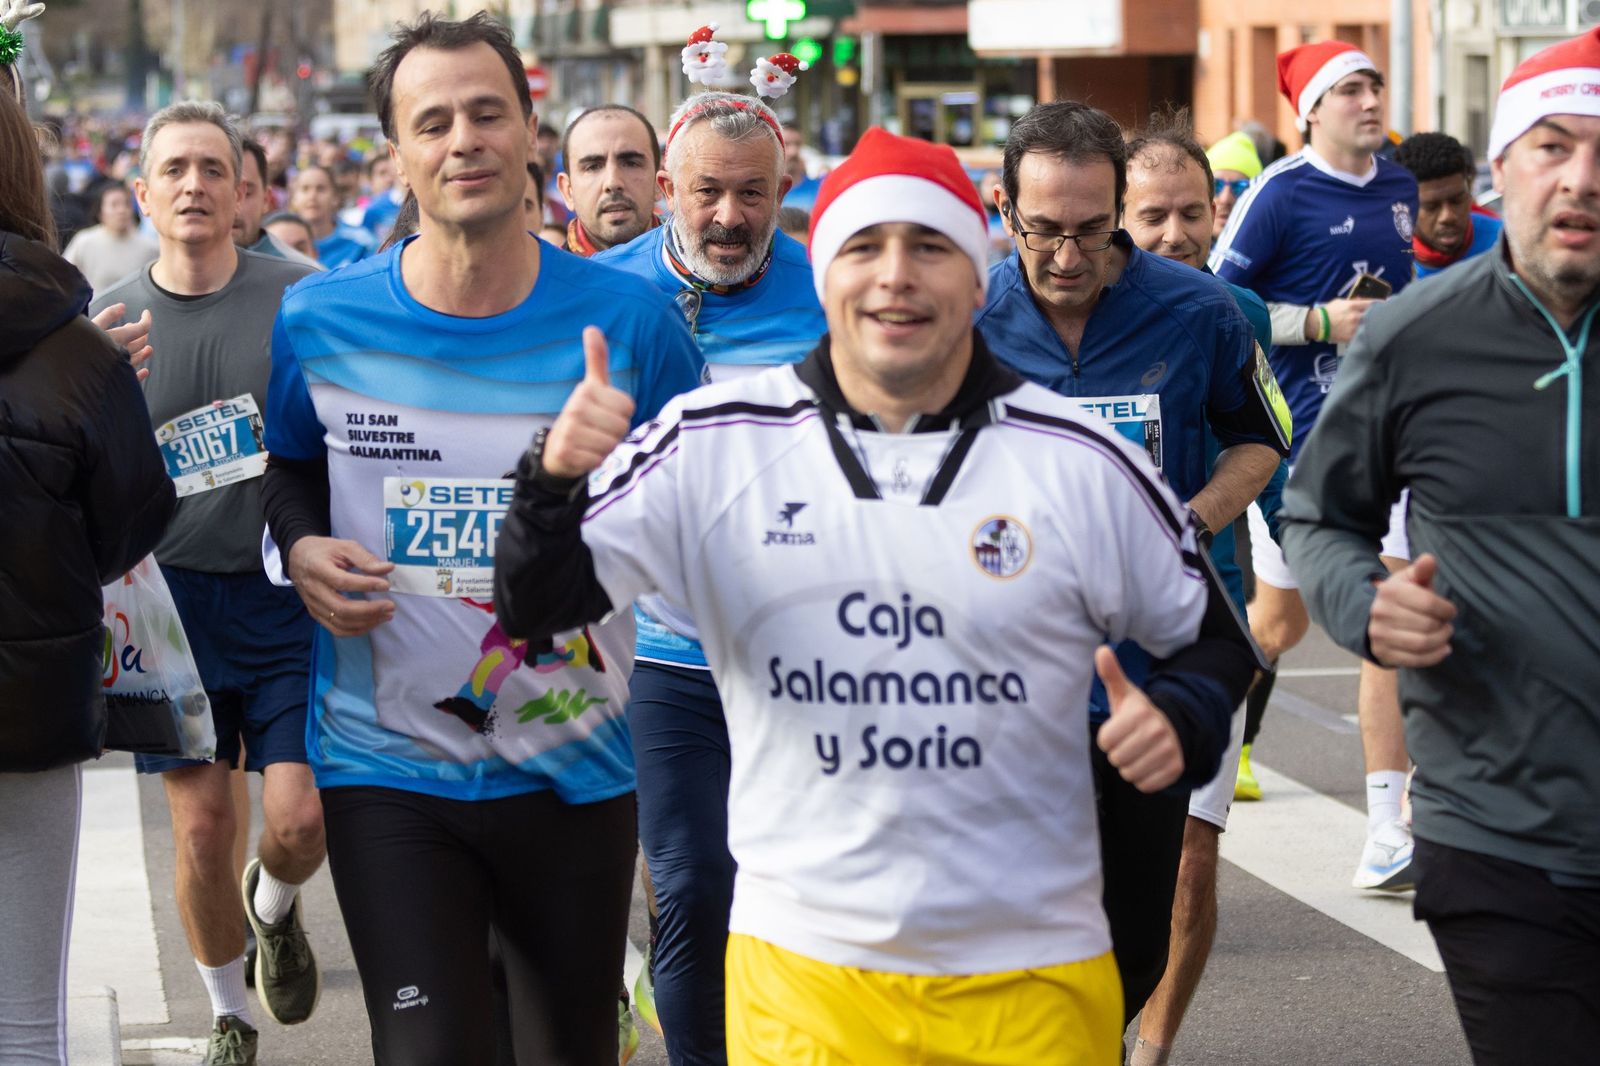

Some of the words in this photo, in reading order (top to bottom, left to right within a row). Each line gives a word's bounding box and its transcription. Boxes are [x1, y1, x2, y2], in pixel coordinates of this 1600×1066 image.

[177, 404, 247, 432] SETEL
[346, 413, 365, 425] XLI
[368, 414, 398, 426] SAN
[1079, 402, 1146, 418] TEL
[169, 421, 238, 470] 3067
[348, 429, 415, 444] SILVESTRE
[349, 445, 442, 461] SALMANTINA
[430, 486, 514, 505] SETE
[838, 592, 945, 650] Caja
[769, 656, 1028, 704] Salamanca
[815, 734, 841, 776] y
[860, 725, 982, 769] Soria
